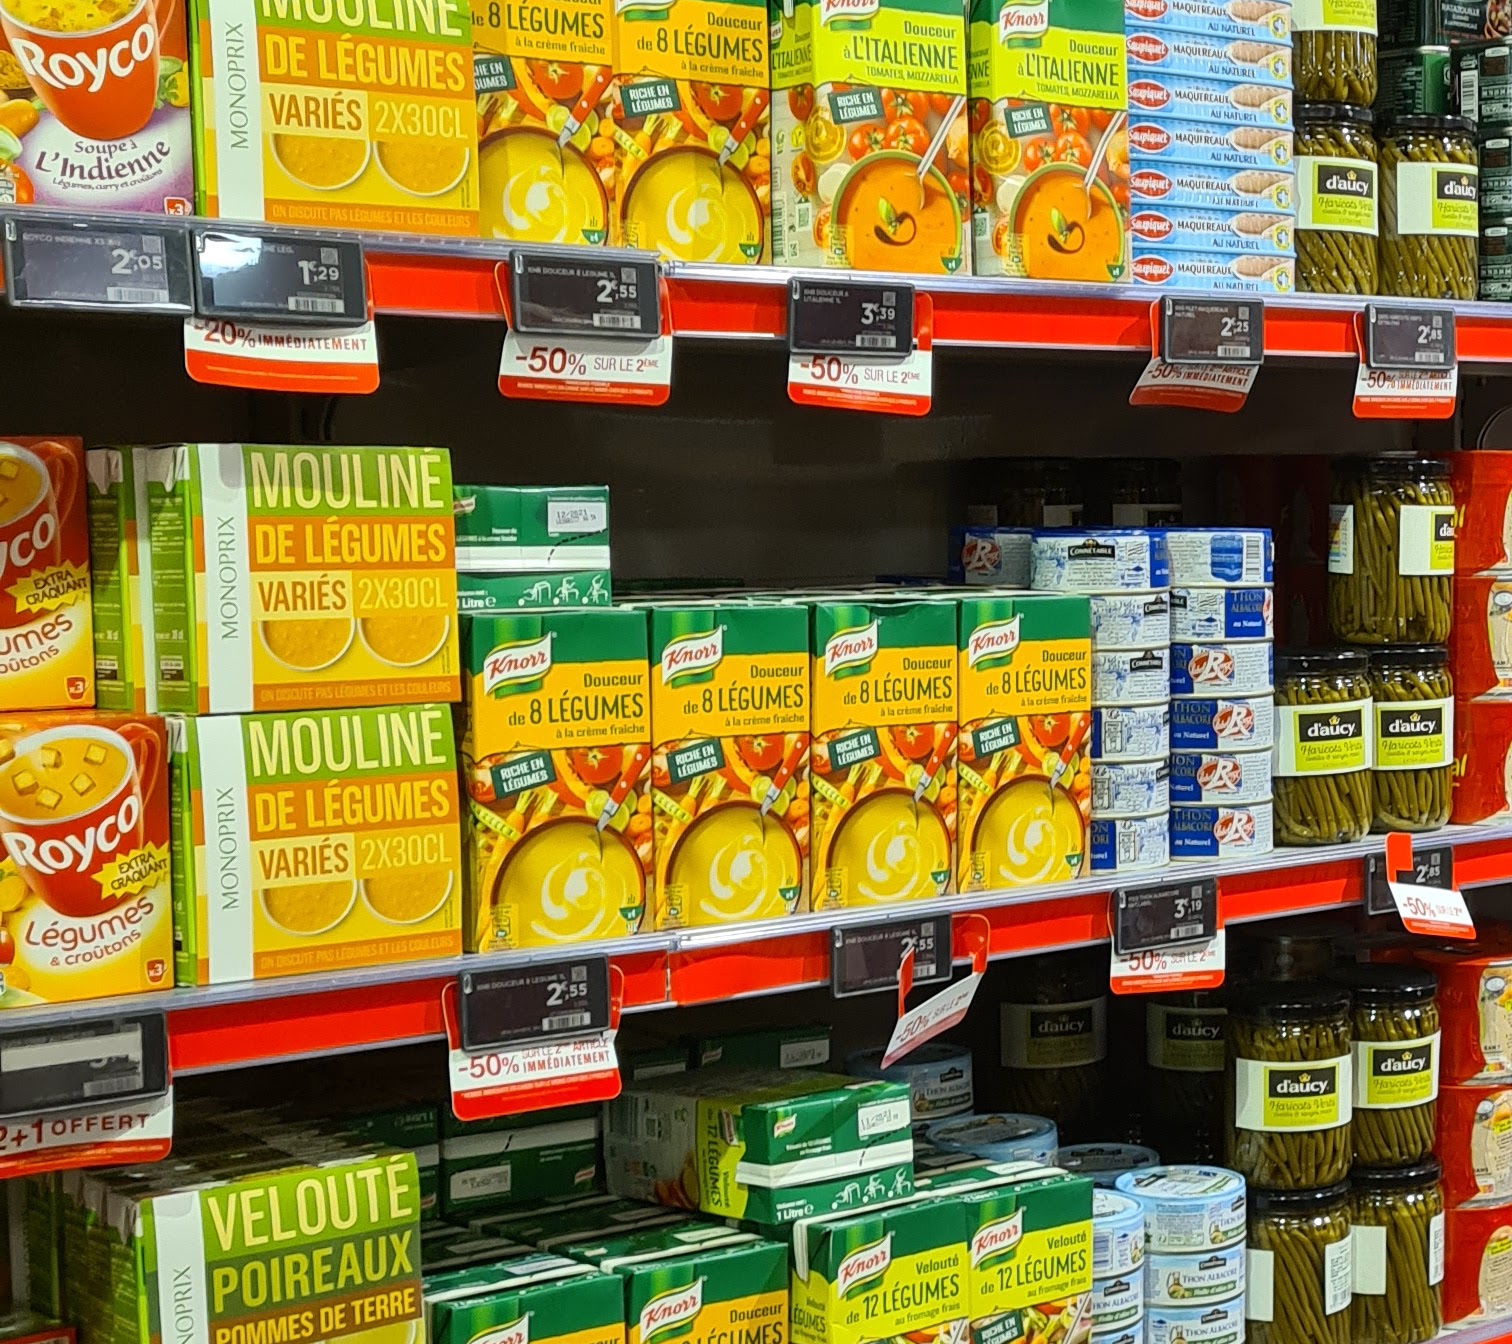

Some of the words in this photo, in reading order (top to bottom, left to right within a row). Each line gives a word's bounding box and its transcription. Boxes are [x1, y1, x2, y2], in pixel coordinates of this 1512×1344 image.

[1171, 0, 1228, 17] MAQUEREAUX
[904, 21, 957, 39] Douceur
[19, 22, 155, 93] Royco
[265, 33, 307, 78] DE
[318, 40, 465, 93] LÉGUMES
[843, 46, 851, 59] à
[853, 35, 959, 71] L'ITALIENNE
[231, 22, 250, 150] MONOPRIX
[906, 71, 960, 86] MOZZARELLA
[268, 92, 362, 133] VARIÉS
[375, 99, 469, 139] 2X30CL
[35, 139, 171, 183] L'Indienne
[74, 138, 128, 156] Soupe
[194, 317, 256, 348] -20%
[515, 346, 587, 375] -50%
[593, 355, 615, 372] SUR
[617, 357, 633, 372] LE
[251, 449, 443, 511] MOULINÉ
[255, 523, 294, 564] DE
[306, 516, 446, 562] LÉGUMES
[25, 577, 88, 605] CRAQUANT
[33, 570, 71, 591] EXTRA
[219, 516, 239, 640] MONOPRIX
[258, 577, 346, 612] VARIÉS
[358, 577, 447, 609] 2X30CL
[971, 630, 1016, 655] Knorr
[1042, 649, 1087, 664] Douceur
[986, 682, 999, 696] de
[1001, 674, 1011, 694] 8
[1015, 668, 1086, 695] LÉGUMES
[248, 704, 447, 777] MOULINÉ
[254, 791, 293, 833] DE
[306, 780, 449, 828] LÉGUMES
[4, 793, 140, 874] Royco
[220, 786, 240, 911] MONOPRIX
[110, 857, 168, 889] CRAQUANT
[117, 854, 151, 875] EXTRA
[258, 837, 349, 878] VARIÉS
[361, 832, 452, 867] 2X30CL
[25, 895, 154, 956] Légumes
[50, 955, 61, 966] &
[64, 928, 141, 966] croûtons
[1275, 1075, 1329, 1097] d'aucy
[51, 1113, 149, 1136] OFFERT
[206, 1155, 413, 1255] VELOUTÉ
[975, 1224, 1021, 1255] Knorr
[1047, 1230, 1087, 1251] Velouté
[212, 1229, 415, 1313] POIREAUX
[980, 1281, 994, 1296] de
[997, 1267, 1012, 1290] 12
[1016, 1250, 1087, 1287] LÉGUMES
[319, 1302, 344, 1329] DE
[350, 1285, 416, 1323] TERRE
